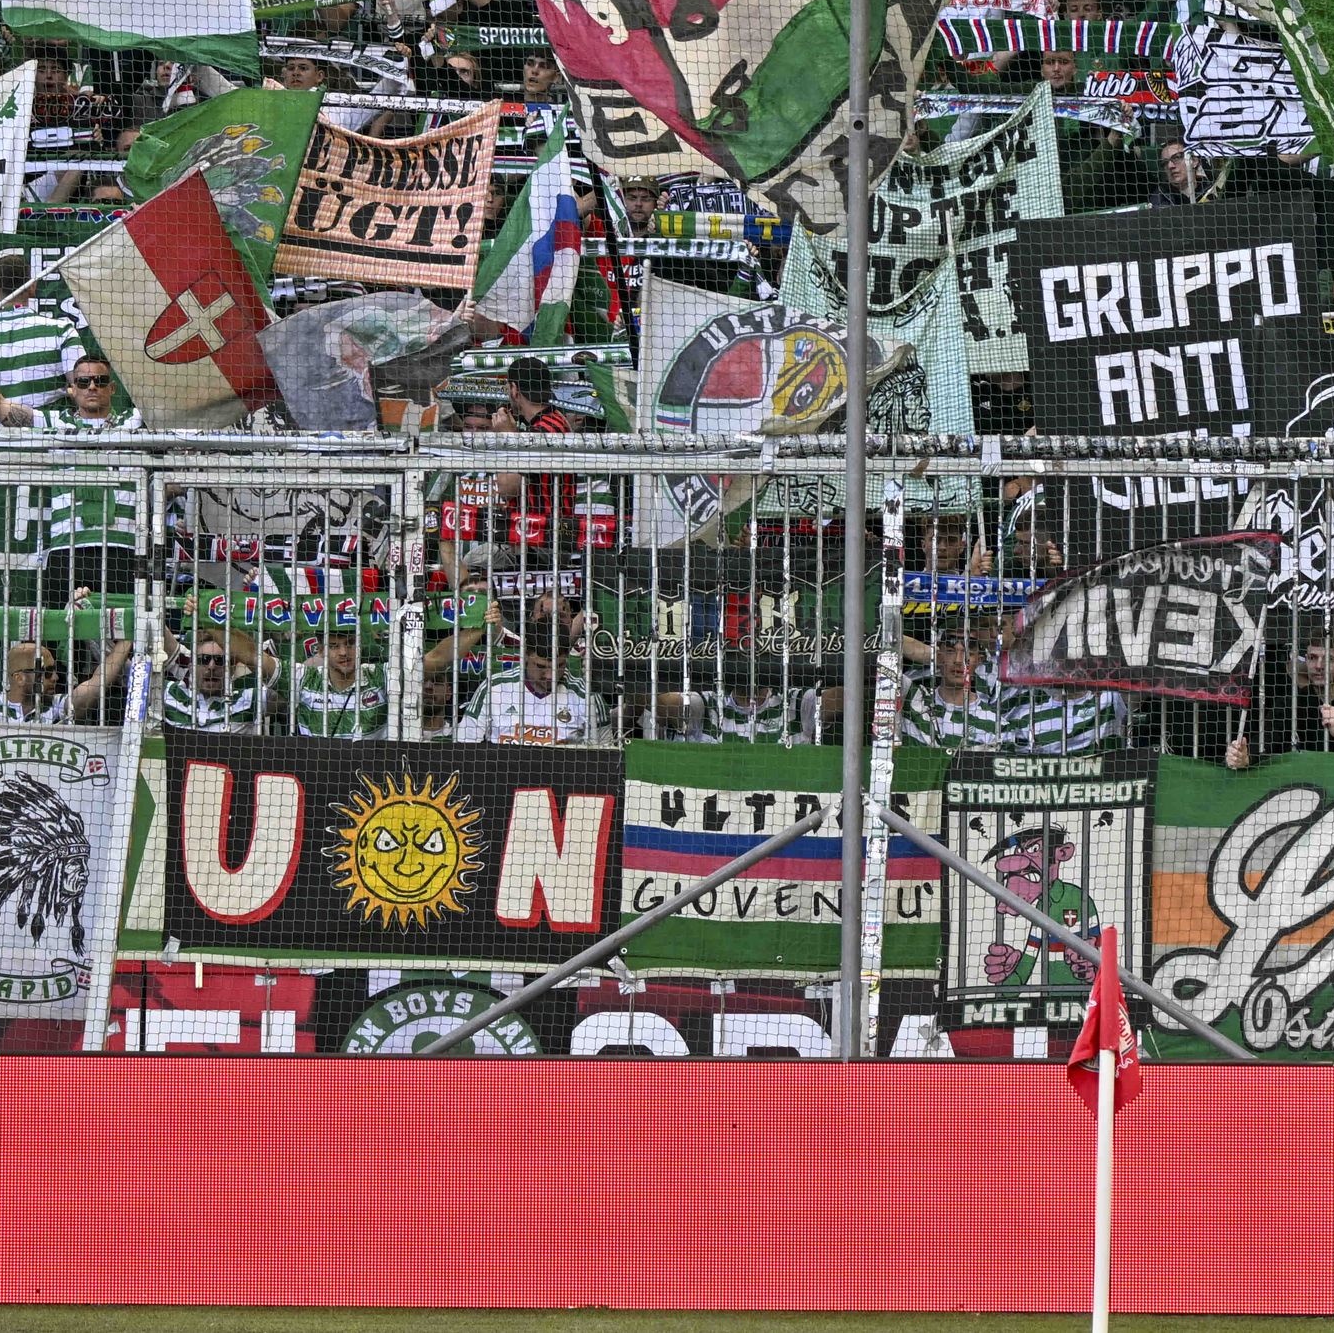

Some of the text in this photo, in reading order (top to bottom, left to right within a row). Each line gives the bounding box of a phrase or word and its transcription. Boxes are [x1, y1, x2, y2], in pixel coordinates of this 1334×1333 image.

[336, 132, 485, 192] PRESSE
[1039, 241, 1302, 343] GRUPPO
[1093, 338, 1250, 427] ANTI
[207, 592, 477, 628] GIOVENU'
[947, 779, 1147, 806] STADIONVERBOT
[633, 878, 935, 919] GIOVENU'
[384, 985, 475, 1028] BOYS
[963, 999, 1037, 1024] MIT
